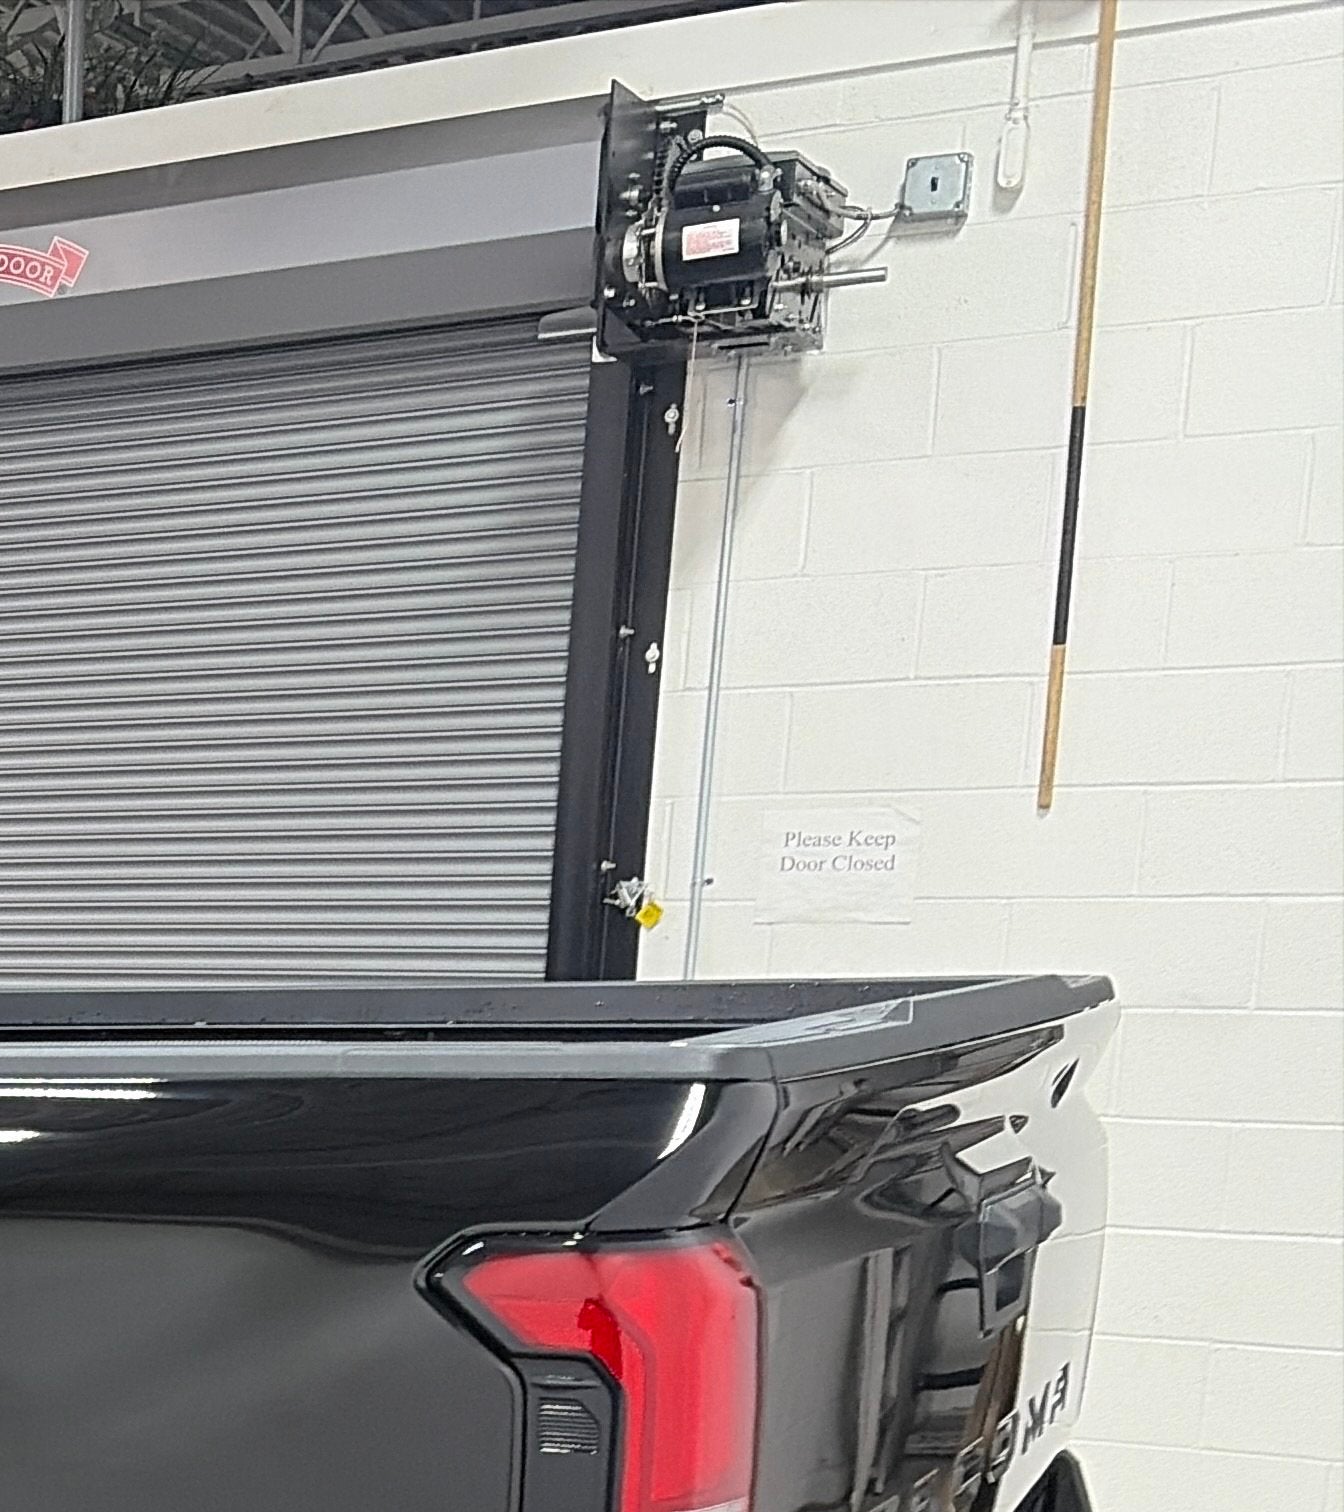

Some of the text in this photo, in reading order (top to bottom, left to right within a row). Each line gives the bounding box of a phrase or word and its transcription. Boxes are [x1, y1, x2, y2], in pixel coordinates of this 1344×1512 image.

[783, 829, 897, 851] Please Keep
[779, 854, 896, 873] Door Closed
